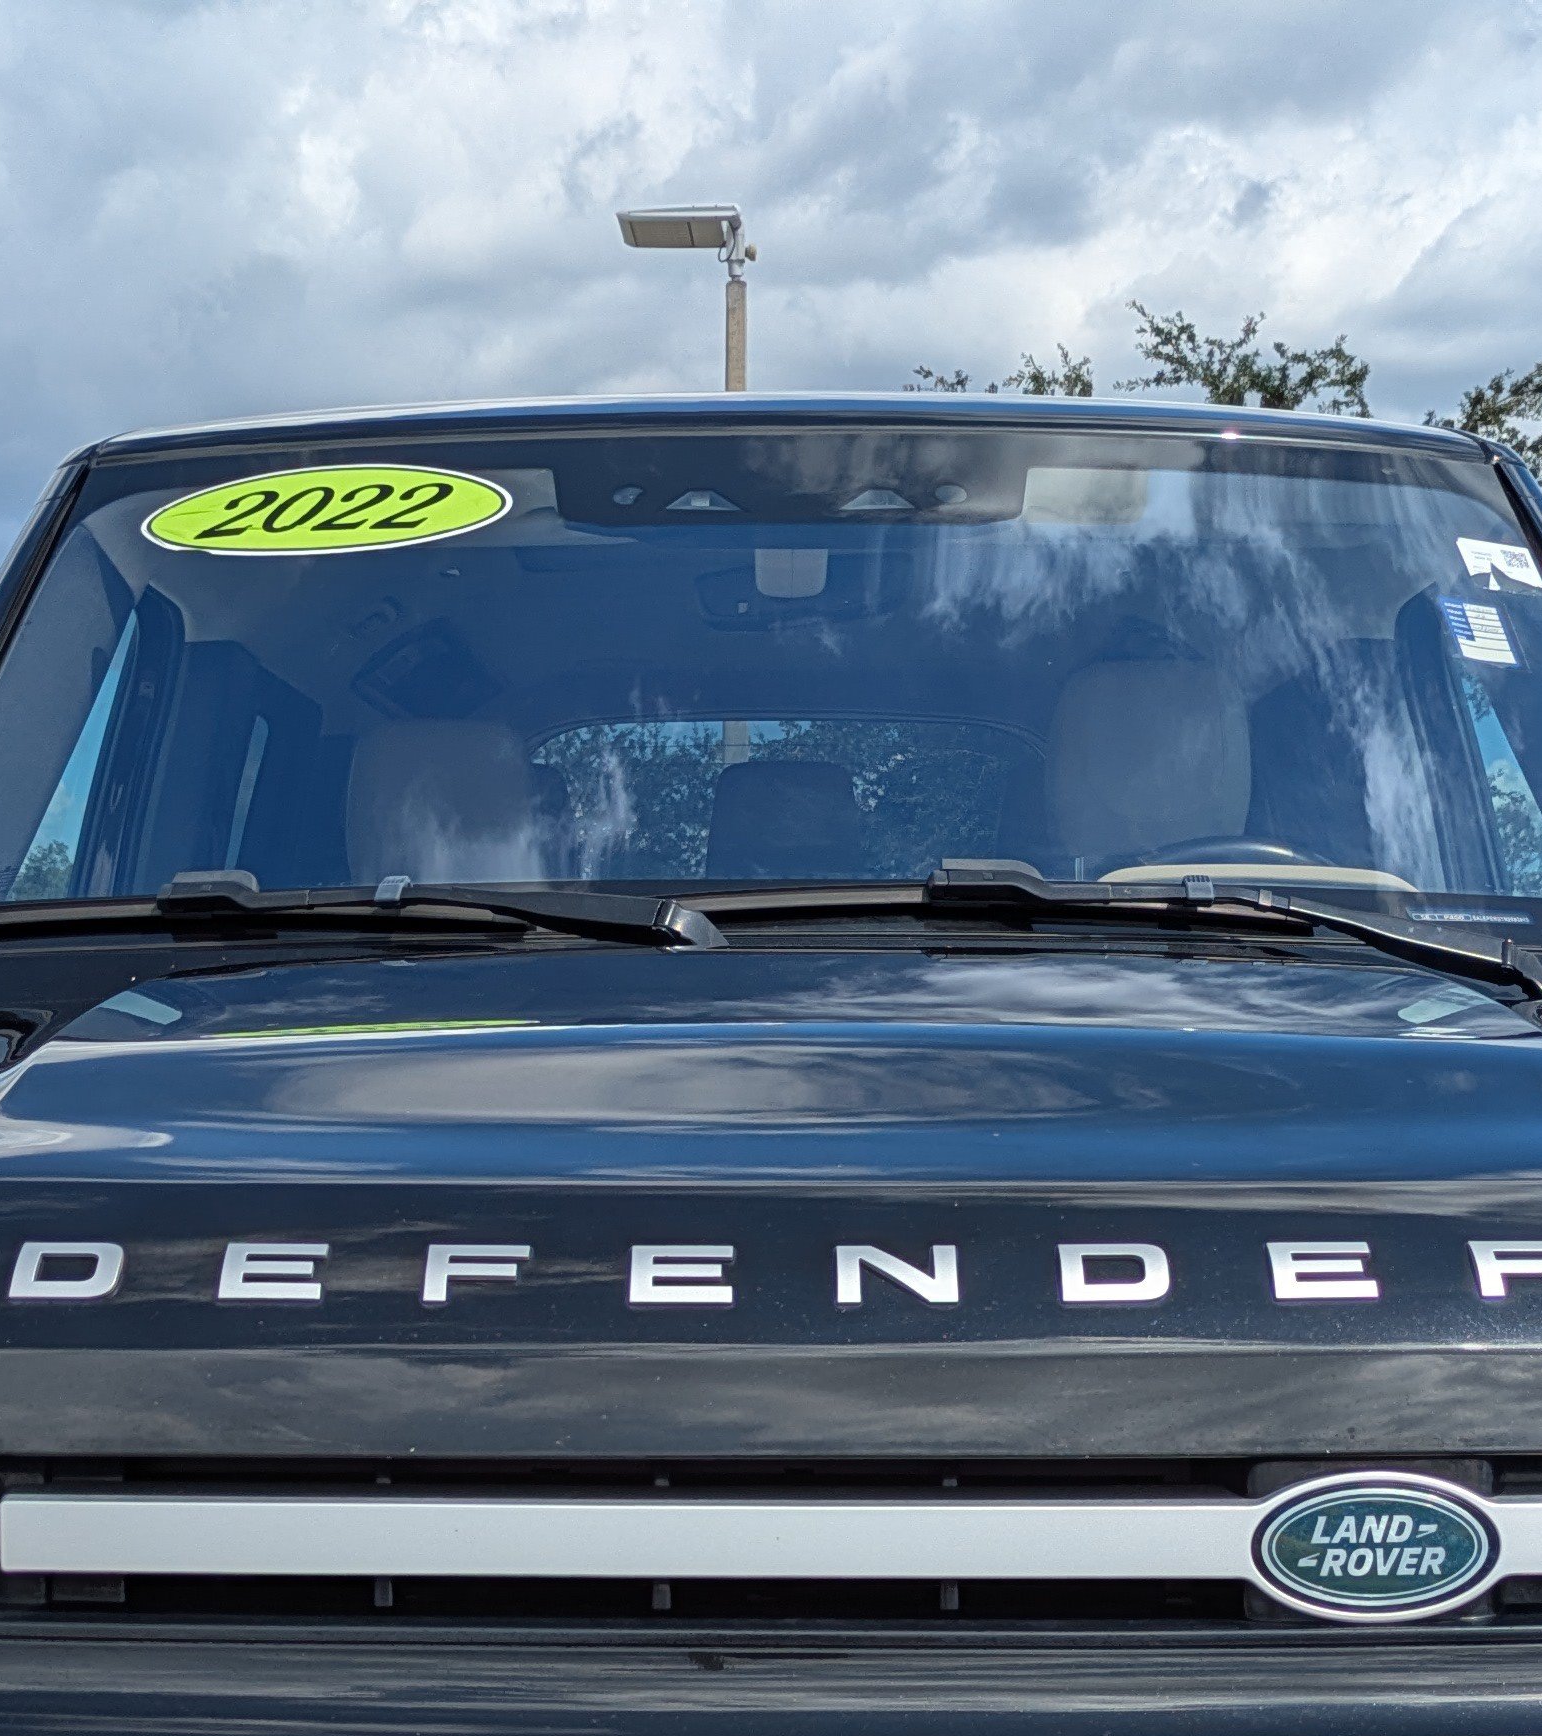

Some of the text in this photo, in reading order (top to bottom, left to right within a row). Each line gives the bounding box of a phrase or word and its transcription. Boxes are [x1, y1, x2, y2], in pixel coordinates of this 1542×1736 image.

[194, 482, 454, 540] 2022
[1311, 1514, 1413, 1544] LAND
[1319, 1546, 1446, 1577] ROVER
